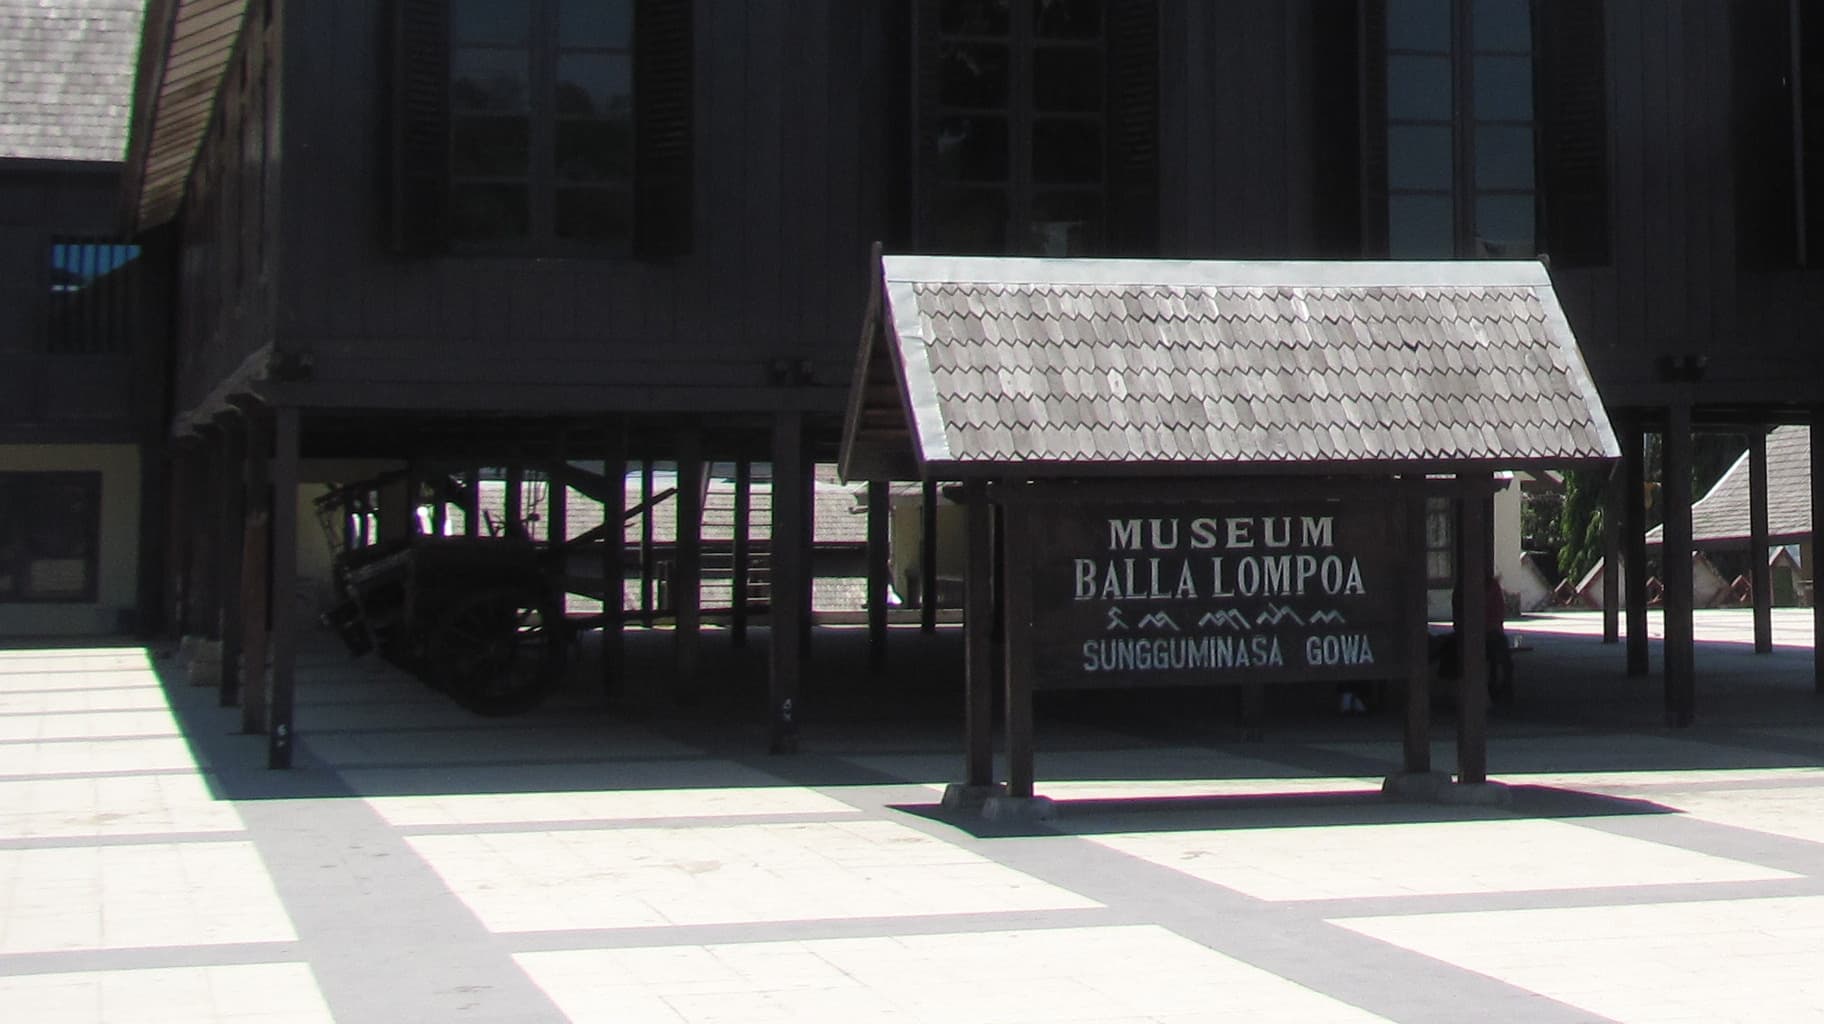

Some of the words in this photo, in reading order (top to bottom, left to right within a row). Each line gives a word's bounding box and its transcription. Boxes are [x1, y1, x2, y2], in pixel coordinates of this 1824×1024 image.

[1108, 517, 1333, 549] MUSEUM
[1075, 558, 1197, 600] BALLA
[1212, 555, 1365, 597] LOMPOA
[1084, 636, 1282, 671] SUNGGUMINASA
[1307, 635, 1373, 664] GOWA
